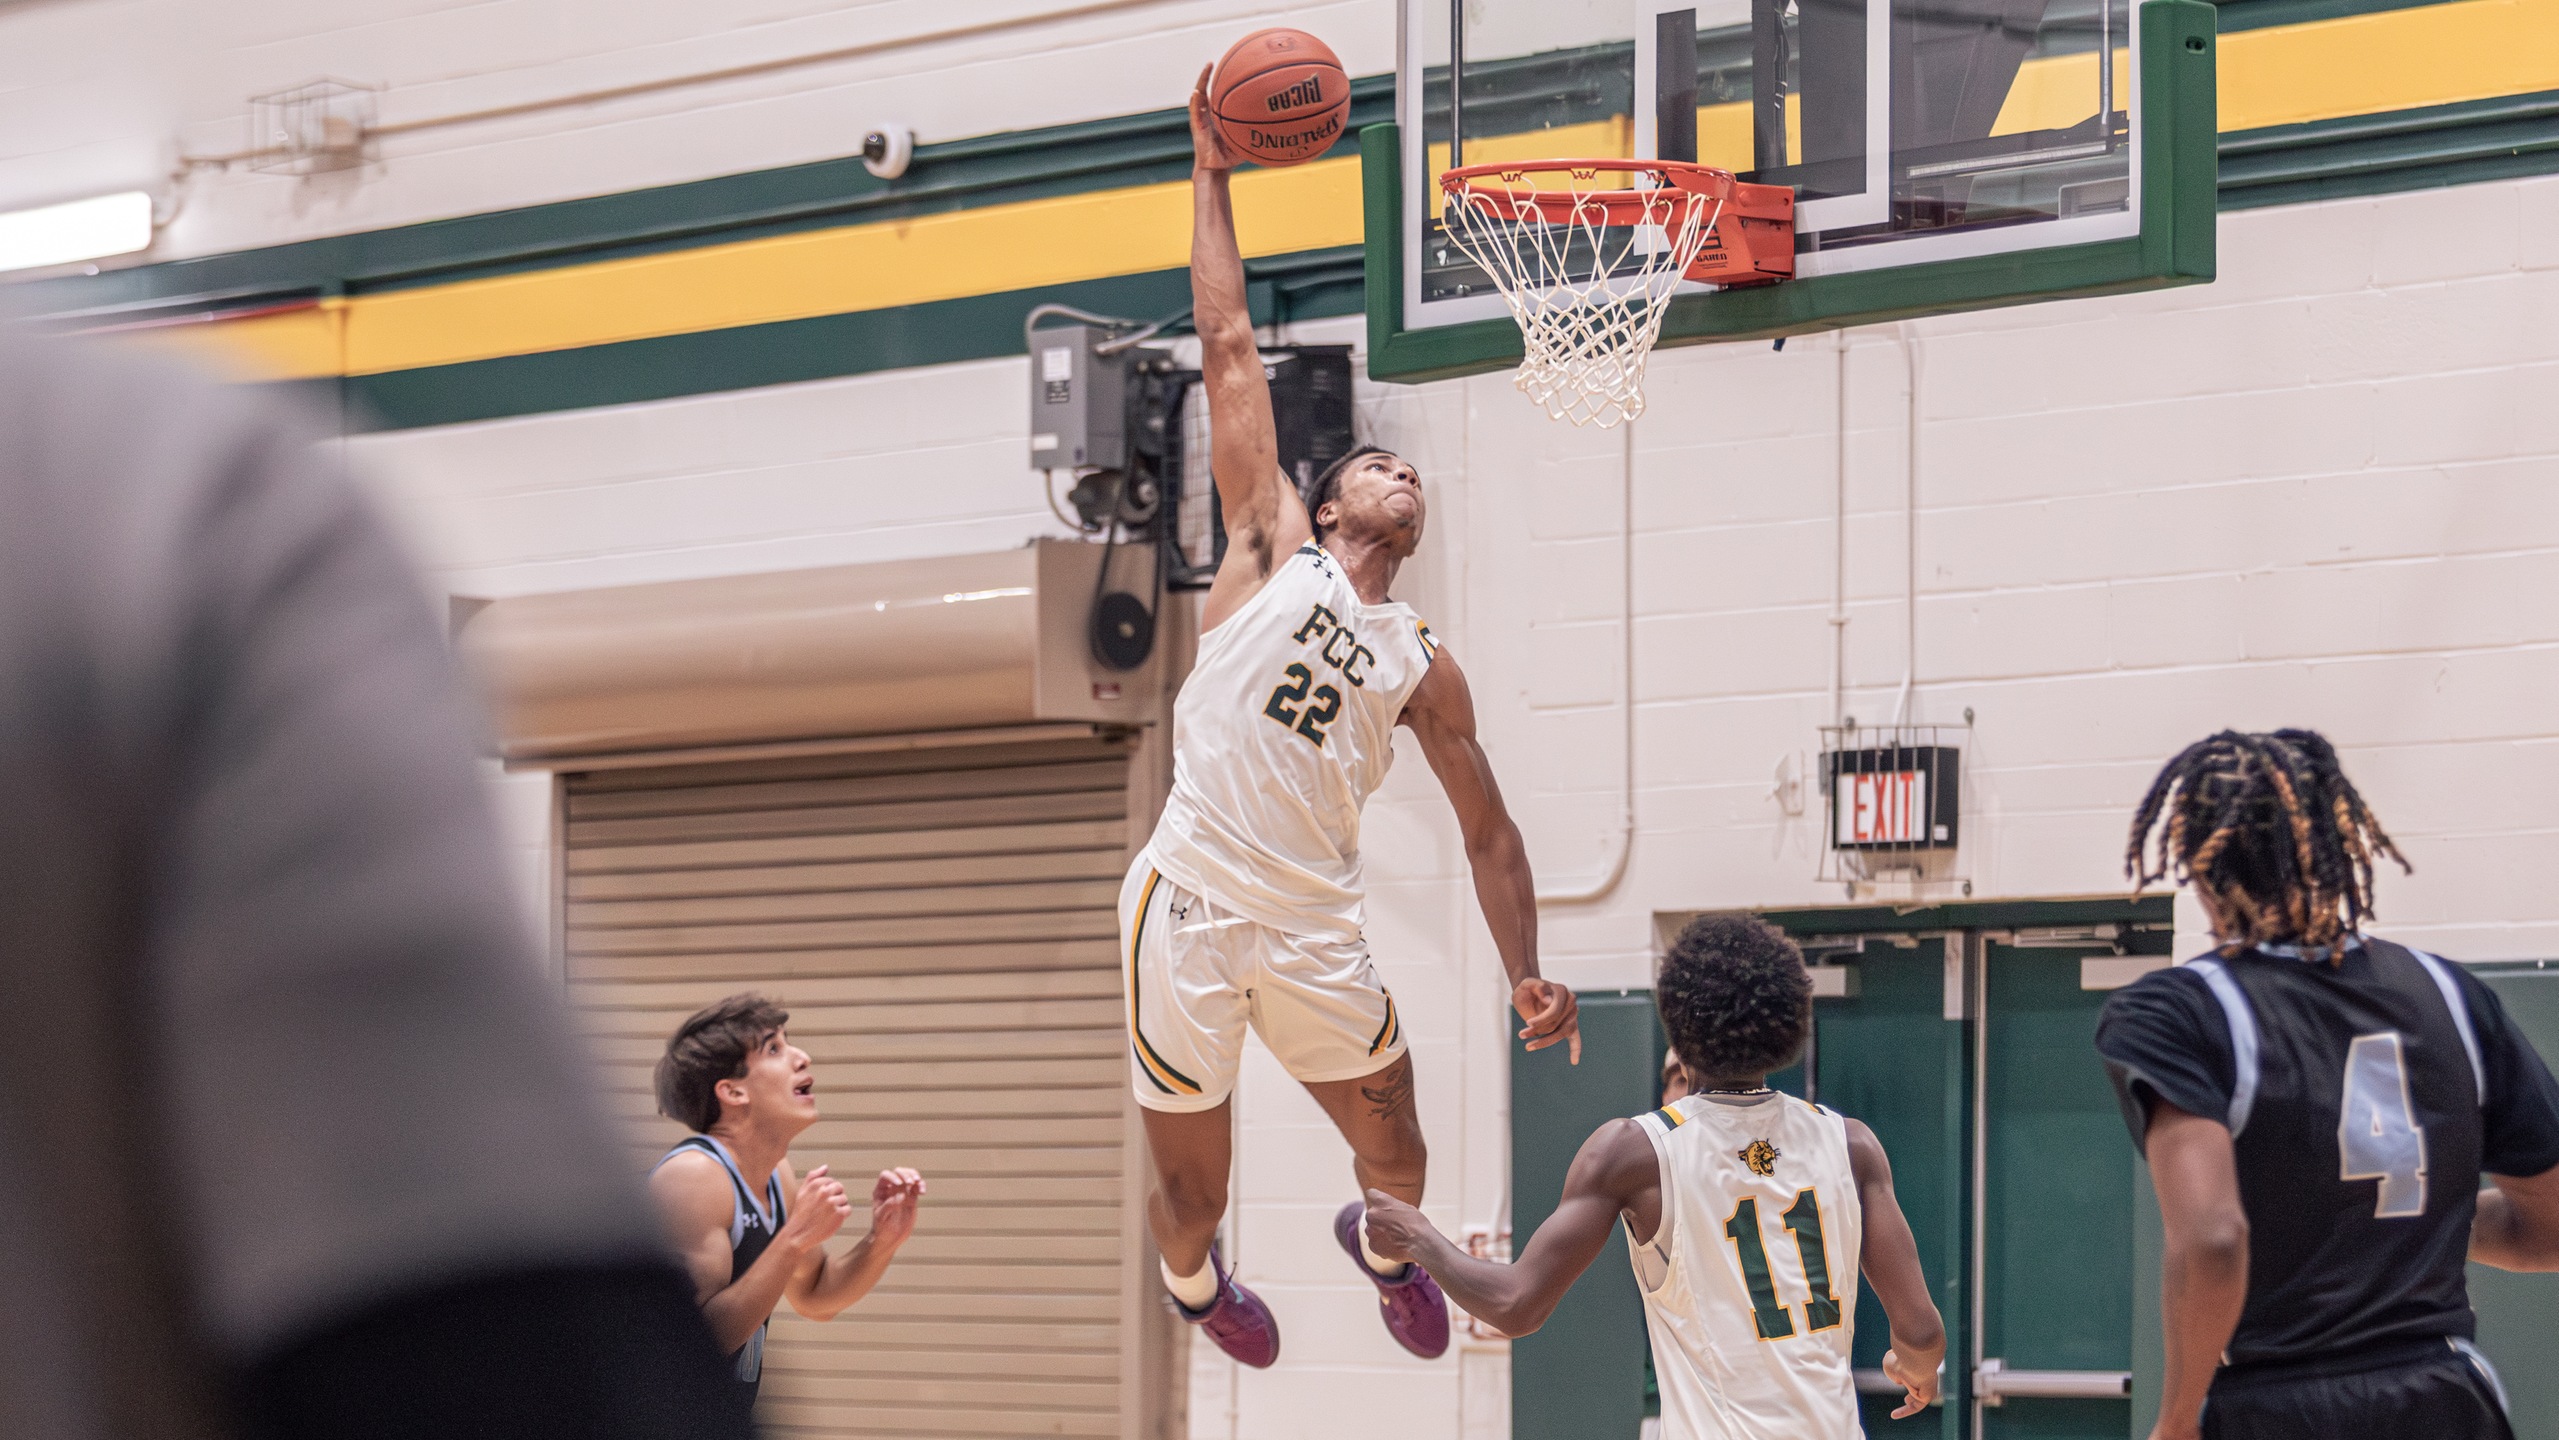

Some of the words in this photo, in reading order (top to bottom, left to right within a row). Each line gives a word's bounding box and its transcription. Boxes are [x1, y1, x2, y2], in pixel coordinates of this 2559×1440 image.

[1292, 603, 1376, 688] FCC
[1262, 662, 1342, 749] 22
[1853, 771, 1915, 842] EXIT
[2337, 1031, 2428, 1220] 4
[1722, 1186, 1843, 1342] 11
